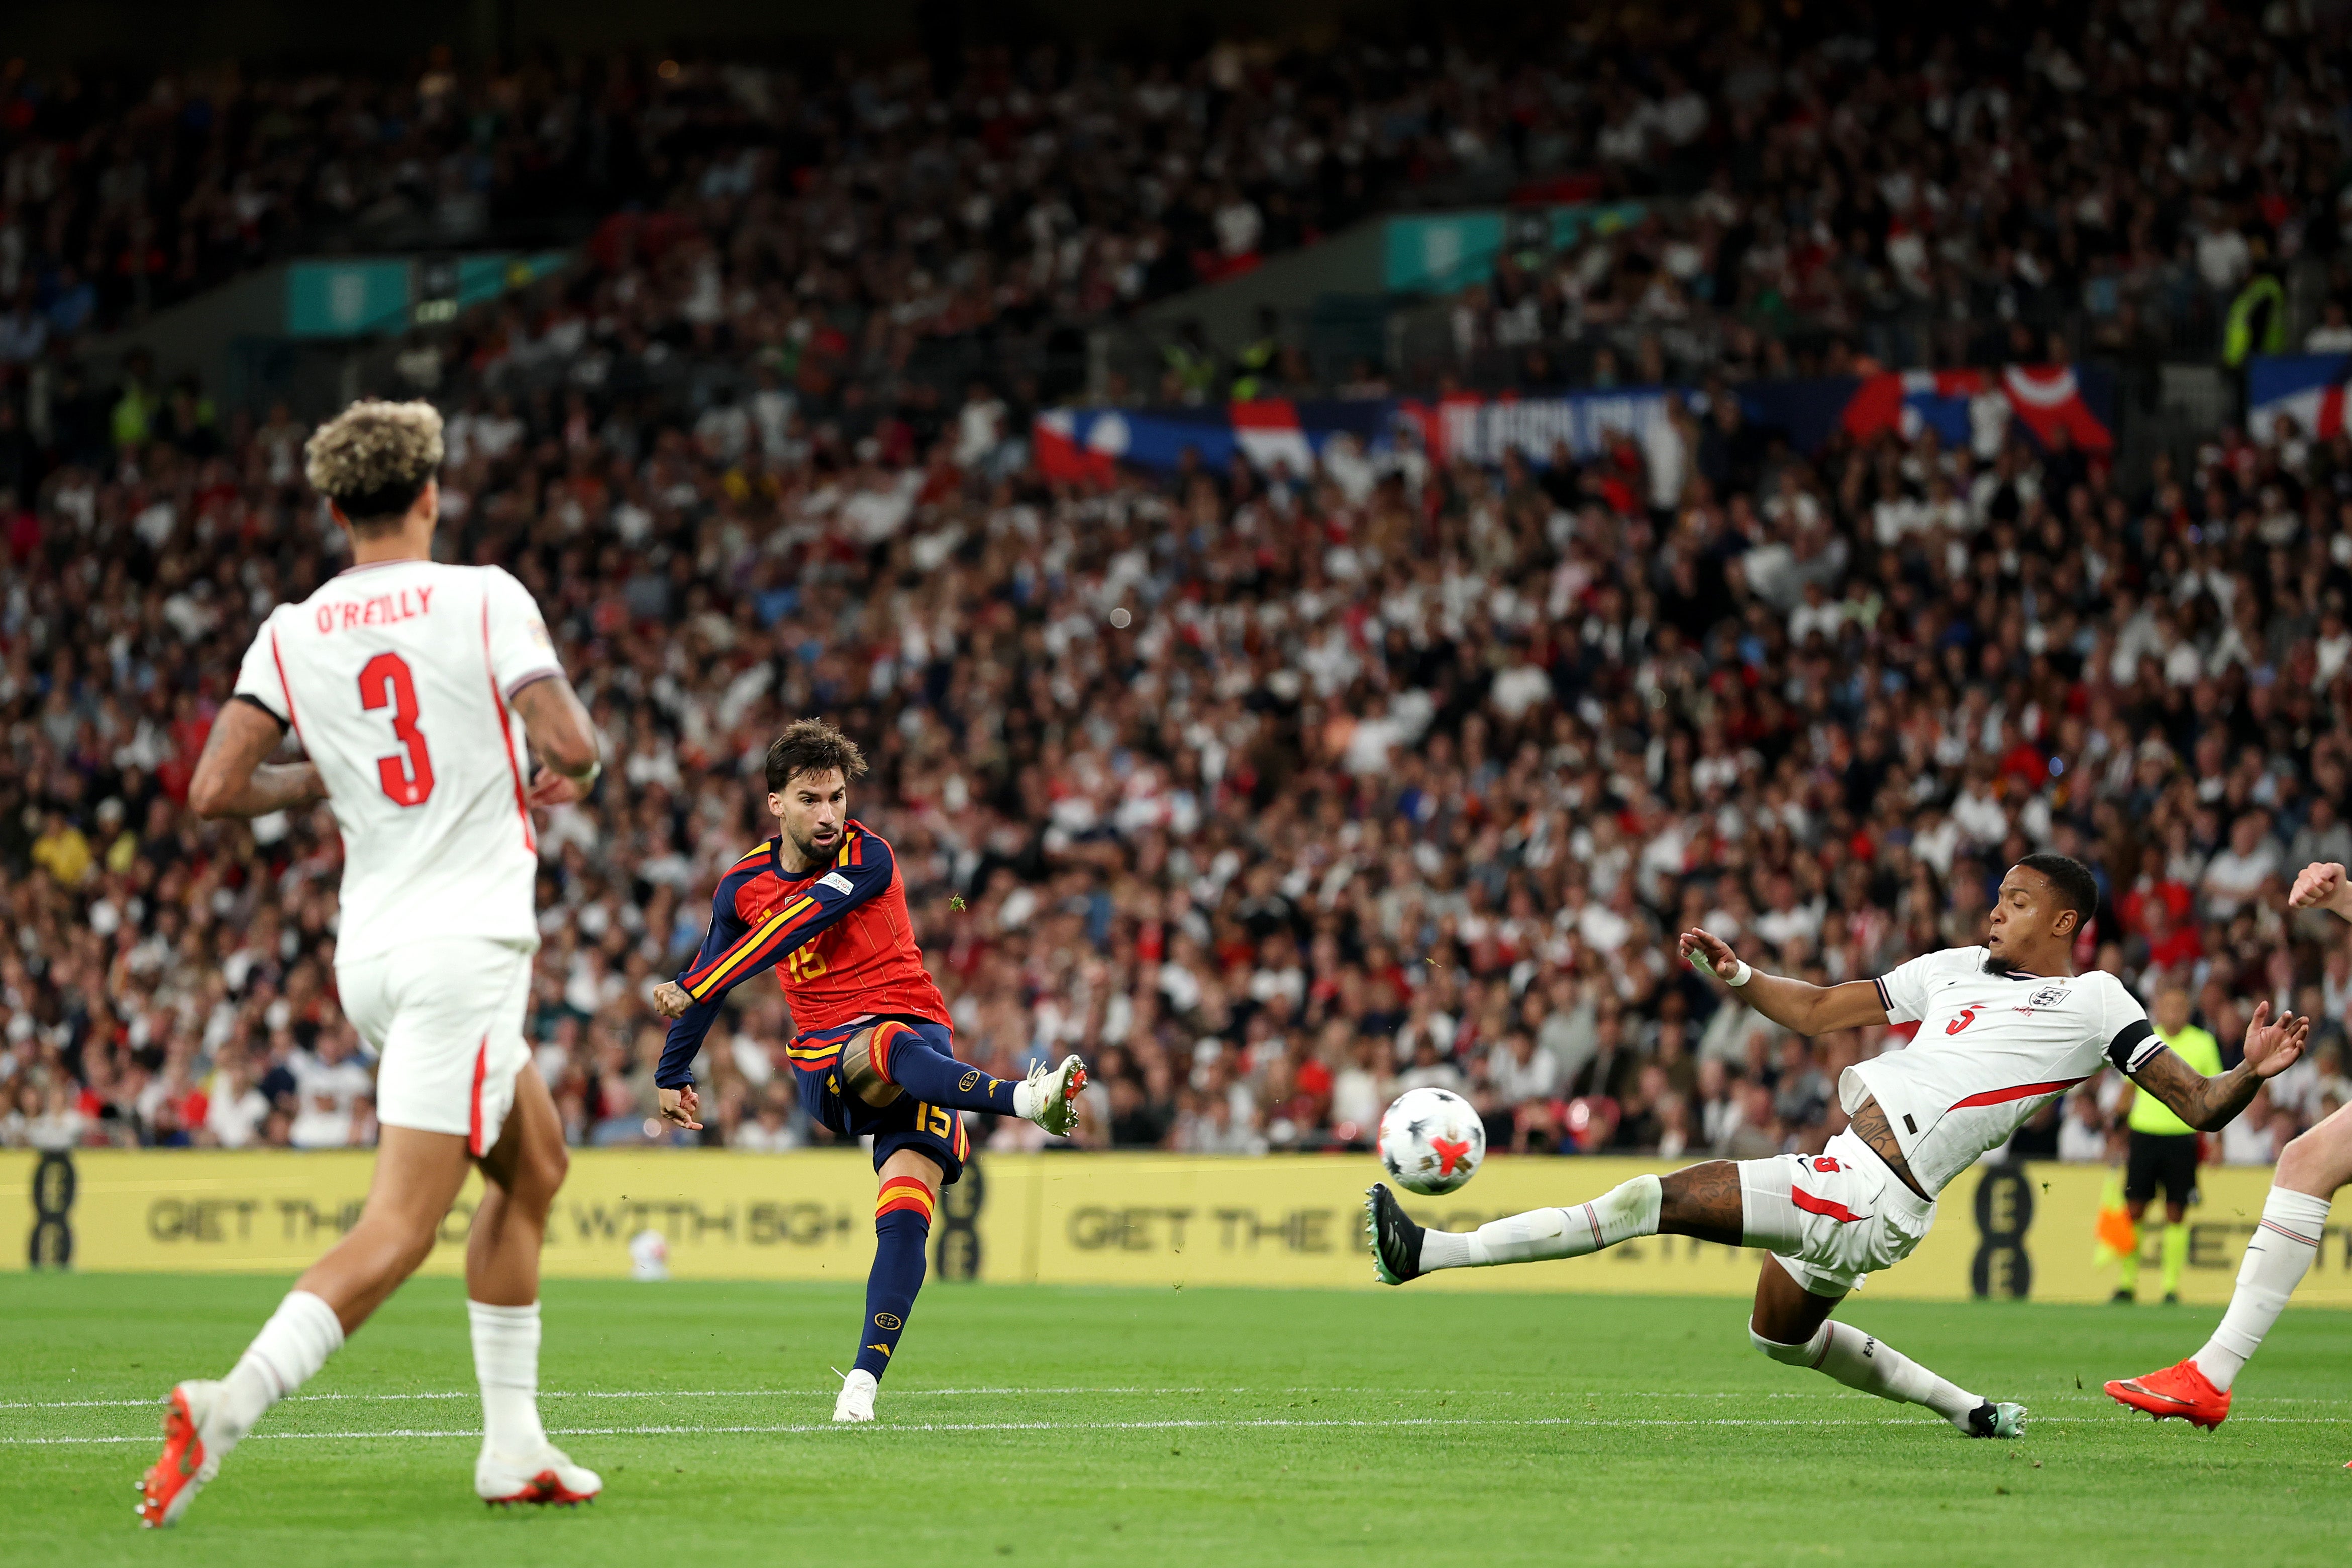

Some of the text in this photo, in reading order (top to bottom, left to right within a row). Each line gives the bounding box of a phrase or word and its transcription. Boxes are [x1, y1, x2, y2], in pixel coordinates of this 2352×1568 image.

[317, 584, 433, 634] O'REILLY
[358, 652, 435, 806] 3
[788, 937, 826, 983] 15
[916, 1101, 951, 1139] 15
[149, 1198, 259, 1242] GET
[1066, 1206, 1192, 1251] GET
[1214, 1207, 1334, 1252] THE
